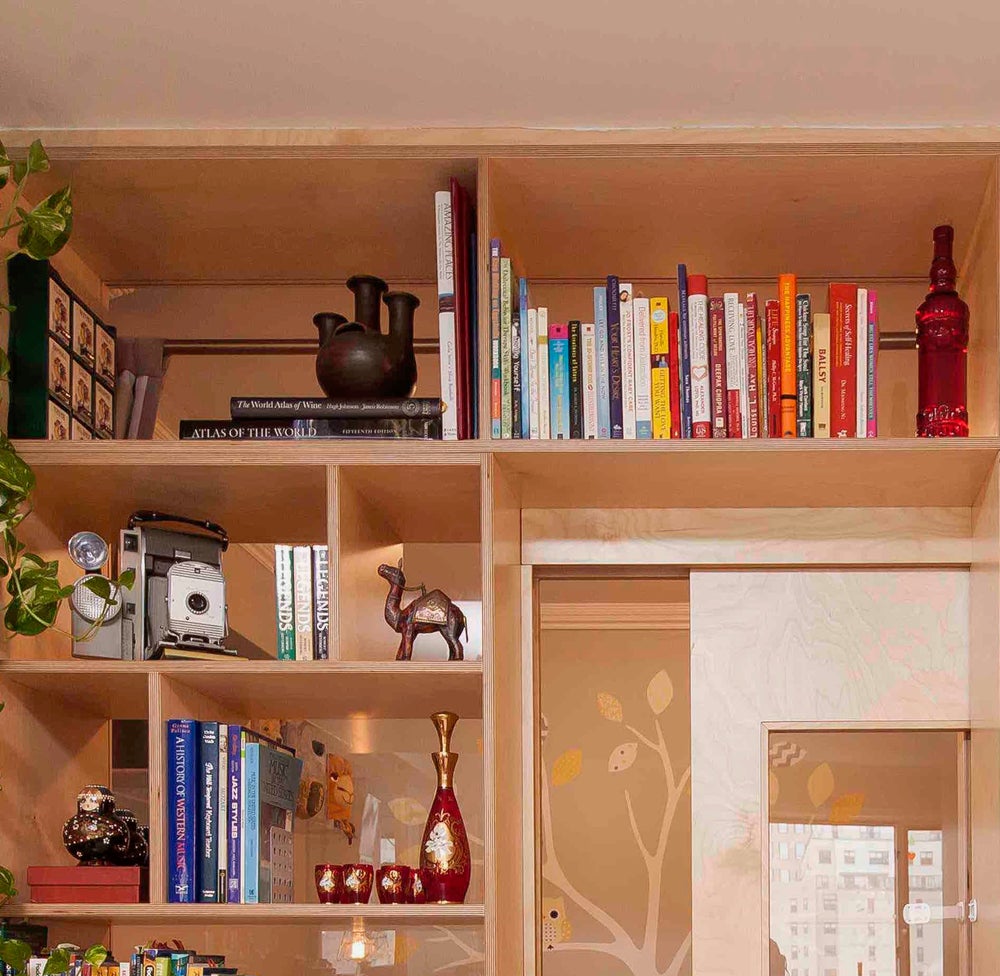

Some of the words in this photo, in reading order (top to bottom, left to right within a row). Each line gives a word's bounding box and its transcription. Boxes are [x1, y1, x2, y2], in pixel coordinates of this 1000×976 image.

[818, 349, 826, 383] BALLSY
[237, 400, 250, 409] The
[251, 400, 273, 408] World
[274, 400, 293, 408] Atlas
[294, 400, 301, 410] of
[303, 400, 322, 408] Wine
[192, 428, 227, 438] ATLAS
[229, 428, 245, 438] OF
[247, 428, 271, 438] THE
[274, 427, 317, 438] WORLD
[176, 745, 185, 786] HISTORY
[176, 787, 185, 798] OF
[176, 799, 185, 840] WESTERN
[177, 842, 186, 871] MUSIC
